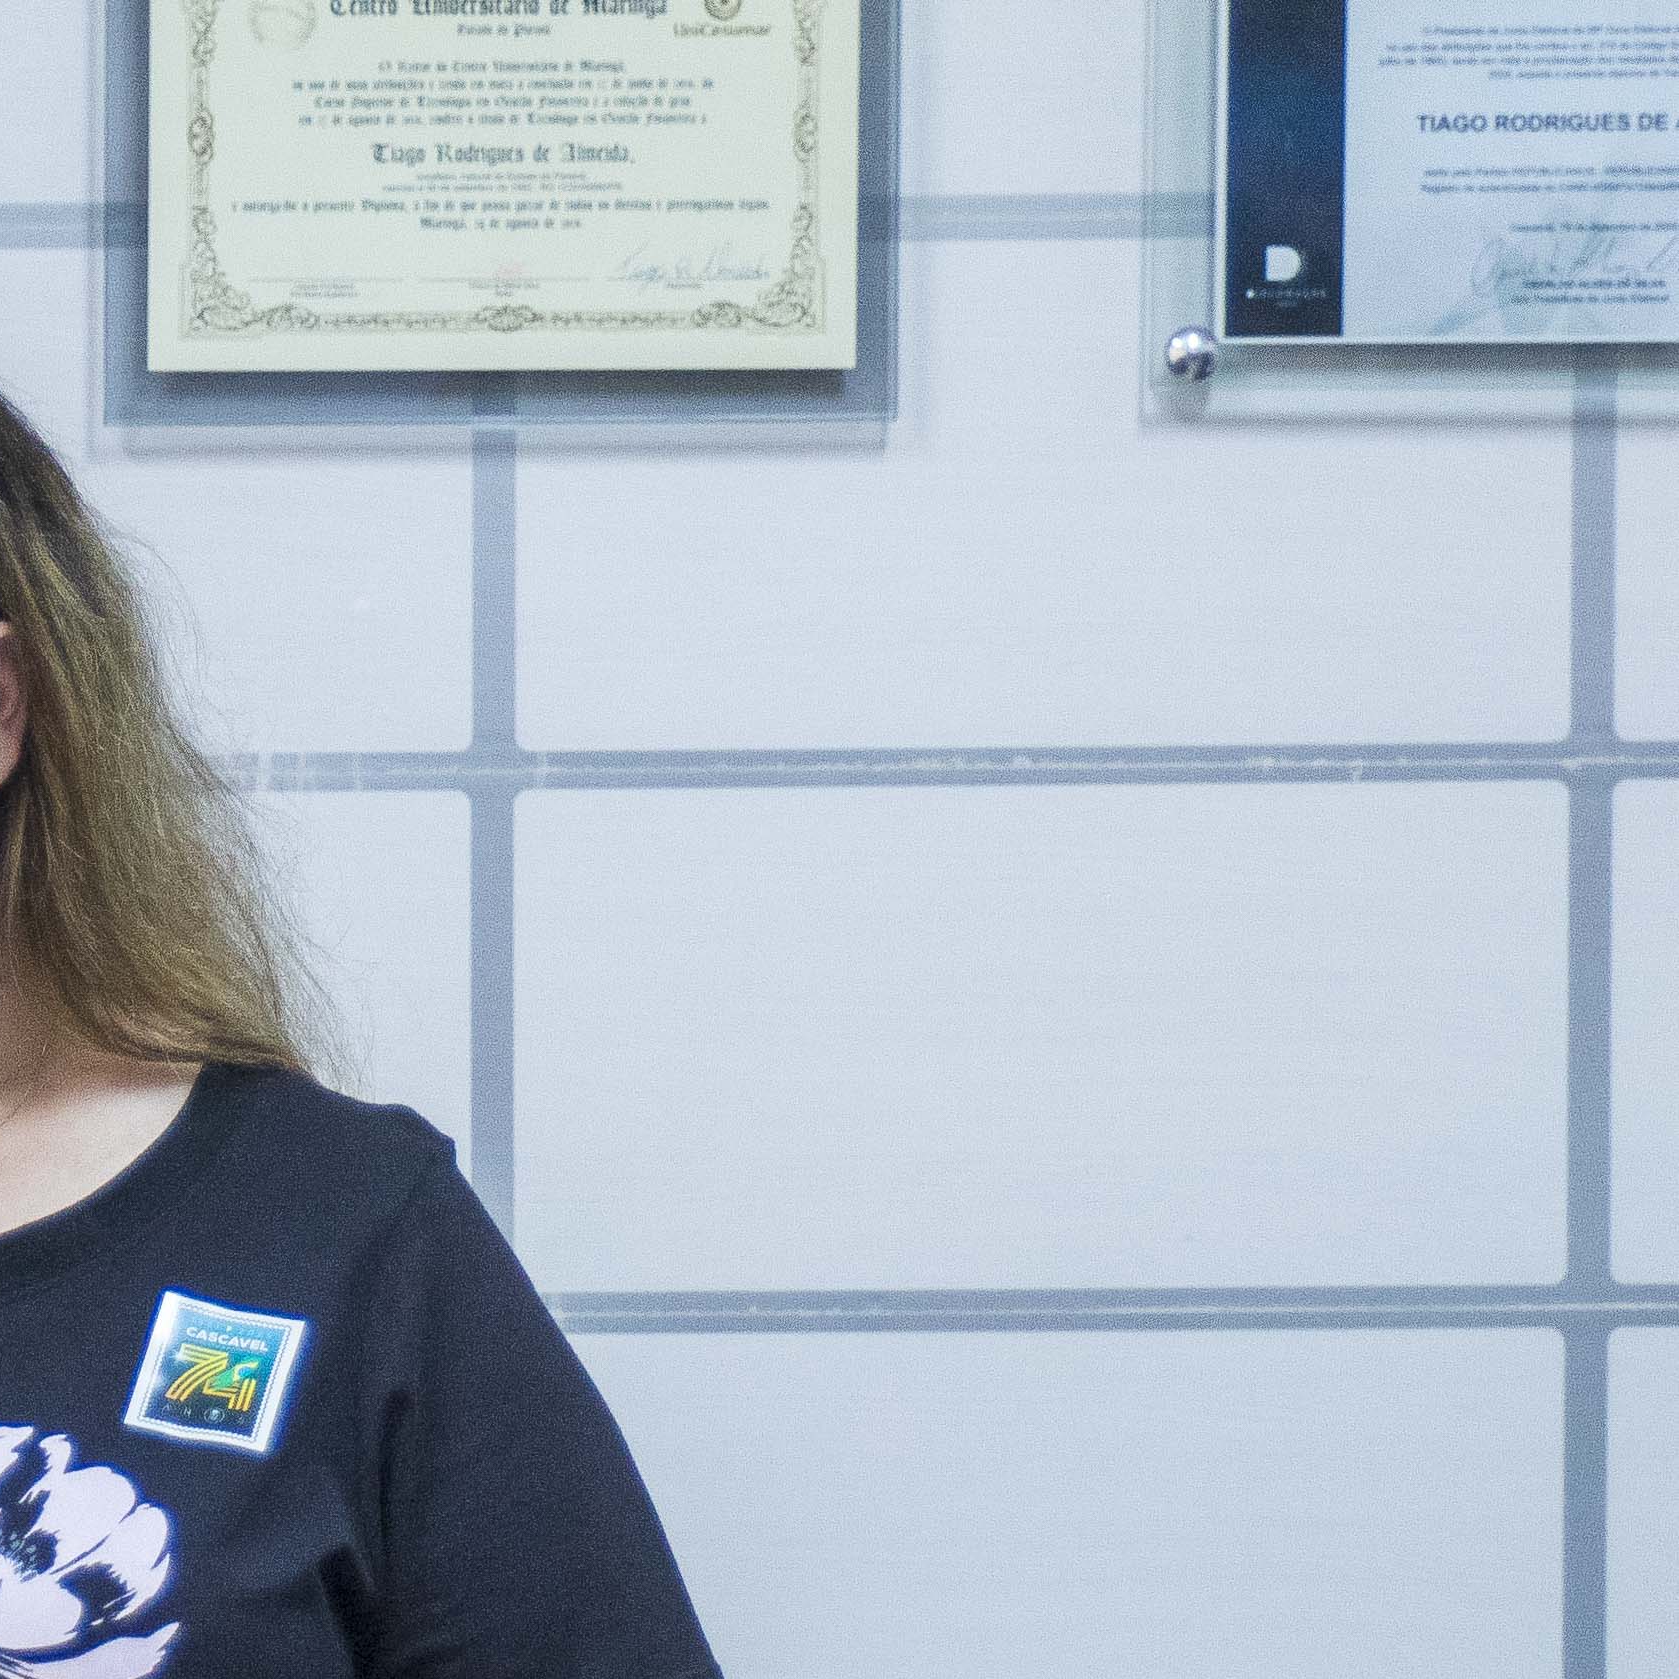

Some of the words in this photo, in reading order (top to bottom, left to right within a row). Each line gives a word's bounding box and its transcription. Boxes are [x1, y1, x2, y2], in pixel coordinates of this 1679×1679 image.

[1417, 113, 1487, 133] TIAGO
[1494, 112, 1632, 132] RODRIGUES
[1638, 112, 1670, 132] DE
[371, 142, 427, 168] Tiago
[434, 142, 525, 168] Rodrigues
[532, 142, 550, 163] de
[185, 1325, 270, 1352] CASCAVEL
[164, 1342, 259, 1413] 74
